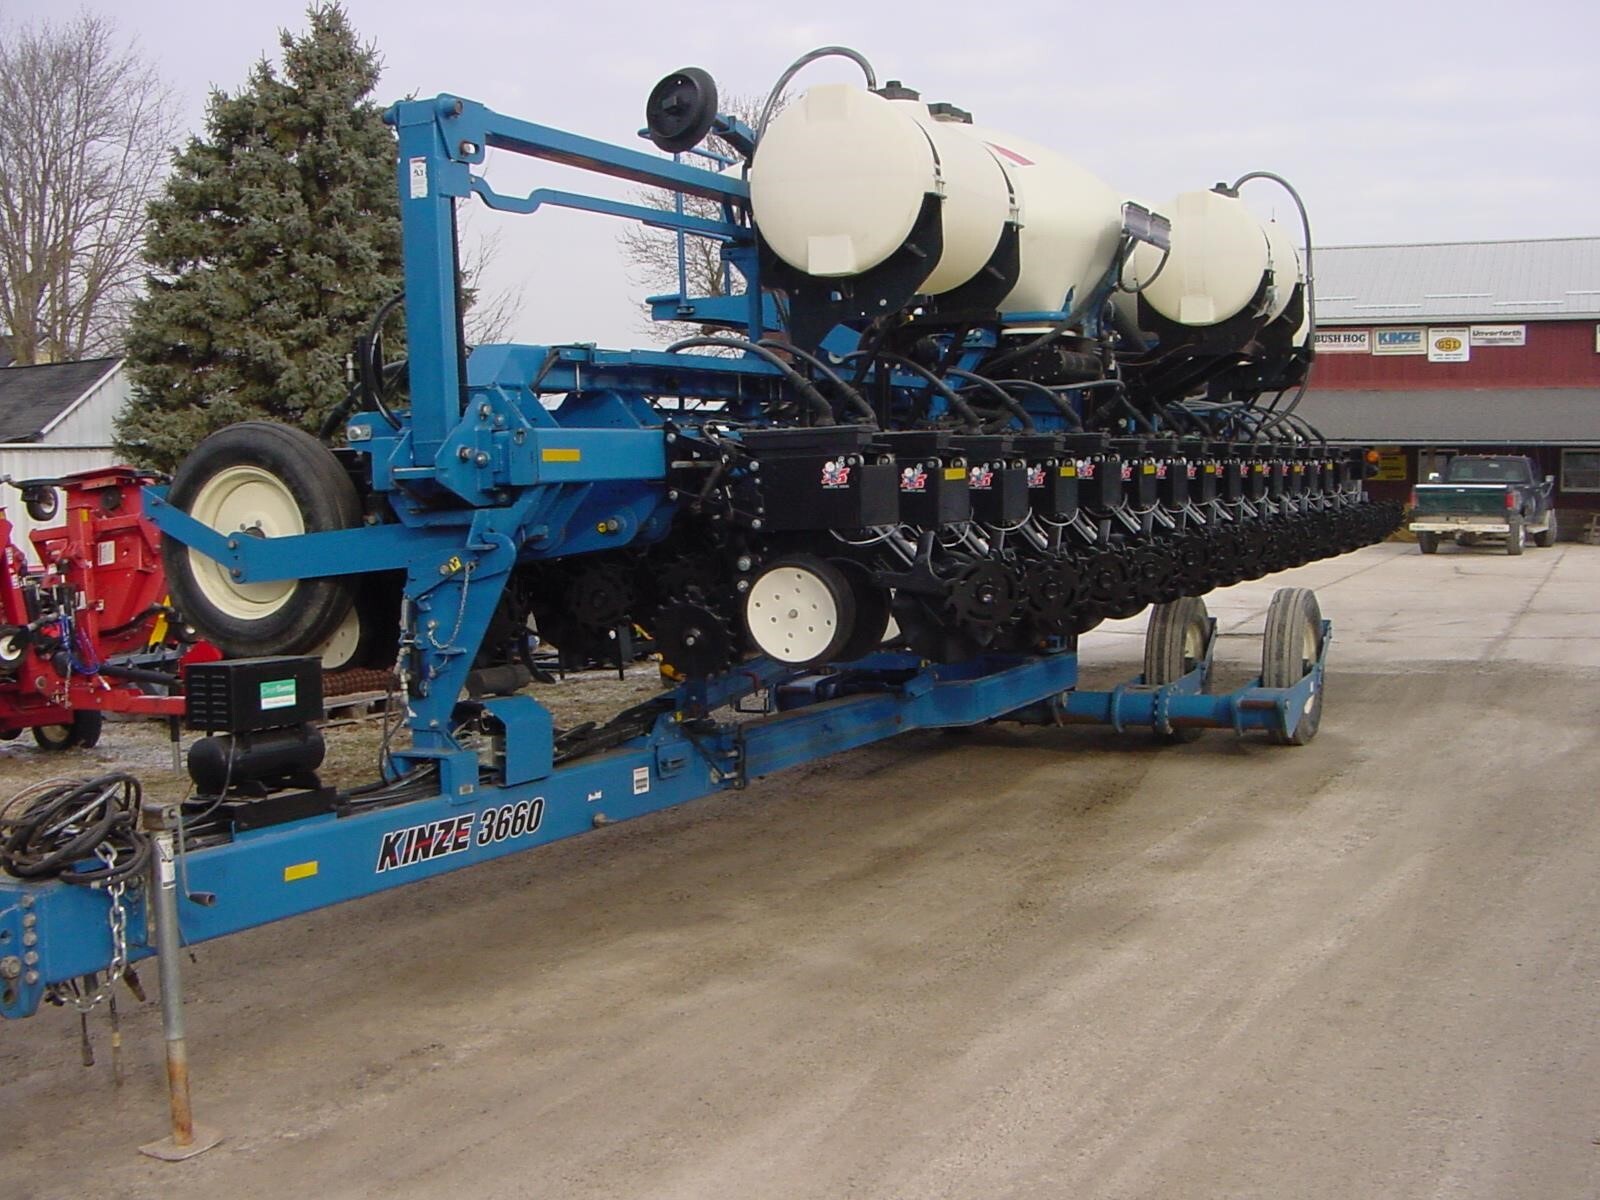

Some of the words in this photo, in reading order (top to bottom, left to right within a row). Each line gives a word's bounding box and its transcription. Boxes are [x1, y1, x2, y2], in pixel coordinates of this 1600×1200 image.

[1314, 334, 1341, 343] BUSH
[1343, 334, 1366, 343] HOG
[1378, 331, 1421, 344] KINZE
[1438, 339, 1457, 350] GSI
[376, 812, 475, 873] KINZE
[476, 797, 545, 847] 3660
